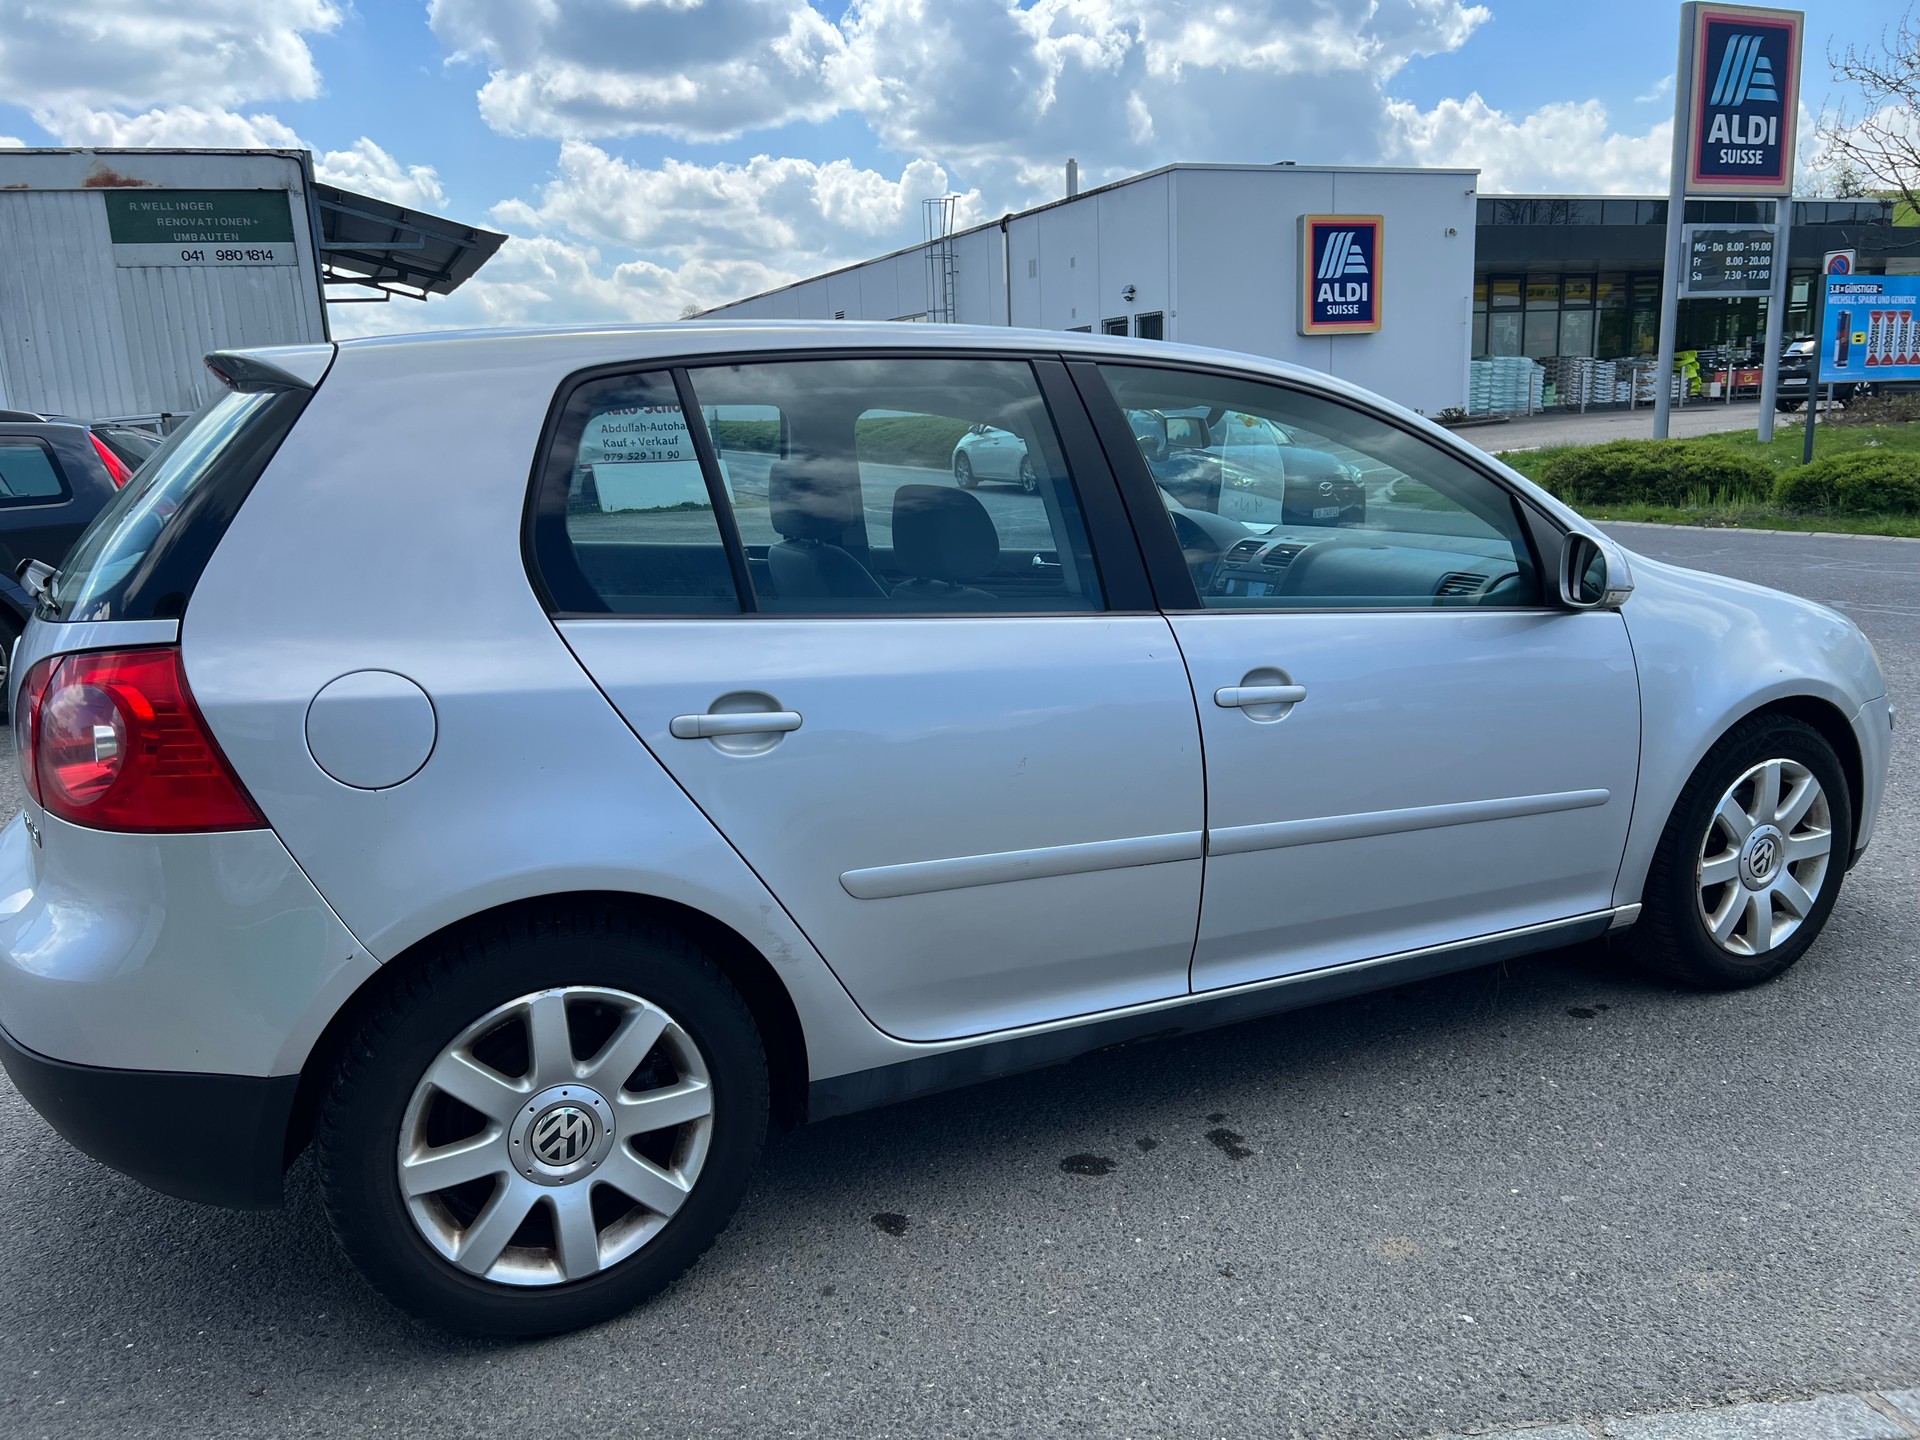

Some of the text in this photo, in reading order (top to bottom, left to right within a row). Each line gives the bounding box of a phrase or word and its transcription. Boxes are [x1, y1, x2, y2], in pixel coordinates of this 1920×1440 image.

[1707, 113, 1777, 146] ALDI
[1719, 148, 1764, 165] SUISSE
[173, 232, 239, 241] UMBAUTEN
[1694, 242, 1706, 252] Mo
[1713, 242, 1724, 252] Do
[1726, 242, 1744, 252] 8.00
[1750, 242, 1772, 251] 19.00
[181, 250, 205, 261] 041
[1693, 257, 1702, 267] Fr
[1725, 256, 1743, 266] 8.00
[1749, 256, 1770, 265] 20.00
[1692, 271, 1702, 280] Sa
[1724, 270, 1742, 280] 7.30
[1748, 270, 1769, 279] 17.00
[1317, 282, 1368, 302] ALDI
[1326, 304, 1359, 315] SUISSE
[601, 421, 686, 434] Abdullah-Autoha
[602, 437, 627, 448] Kauf
[638, 435, 679, 447] Verkauf
[603, 450, 680, 462] 079 529 11 90
